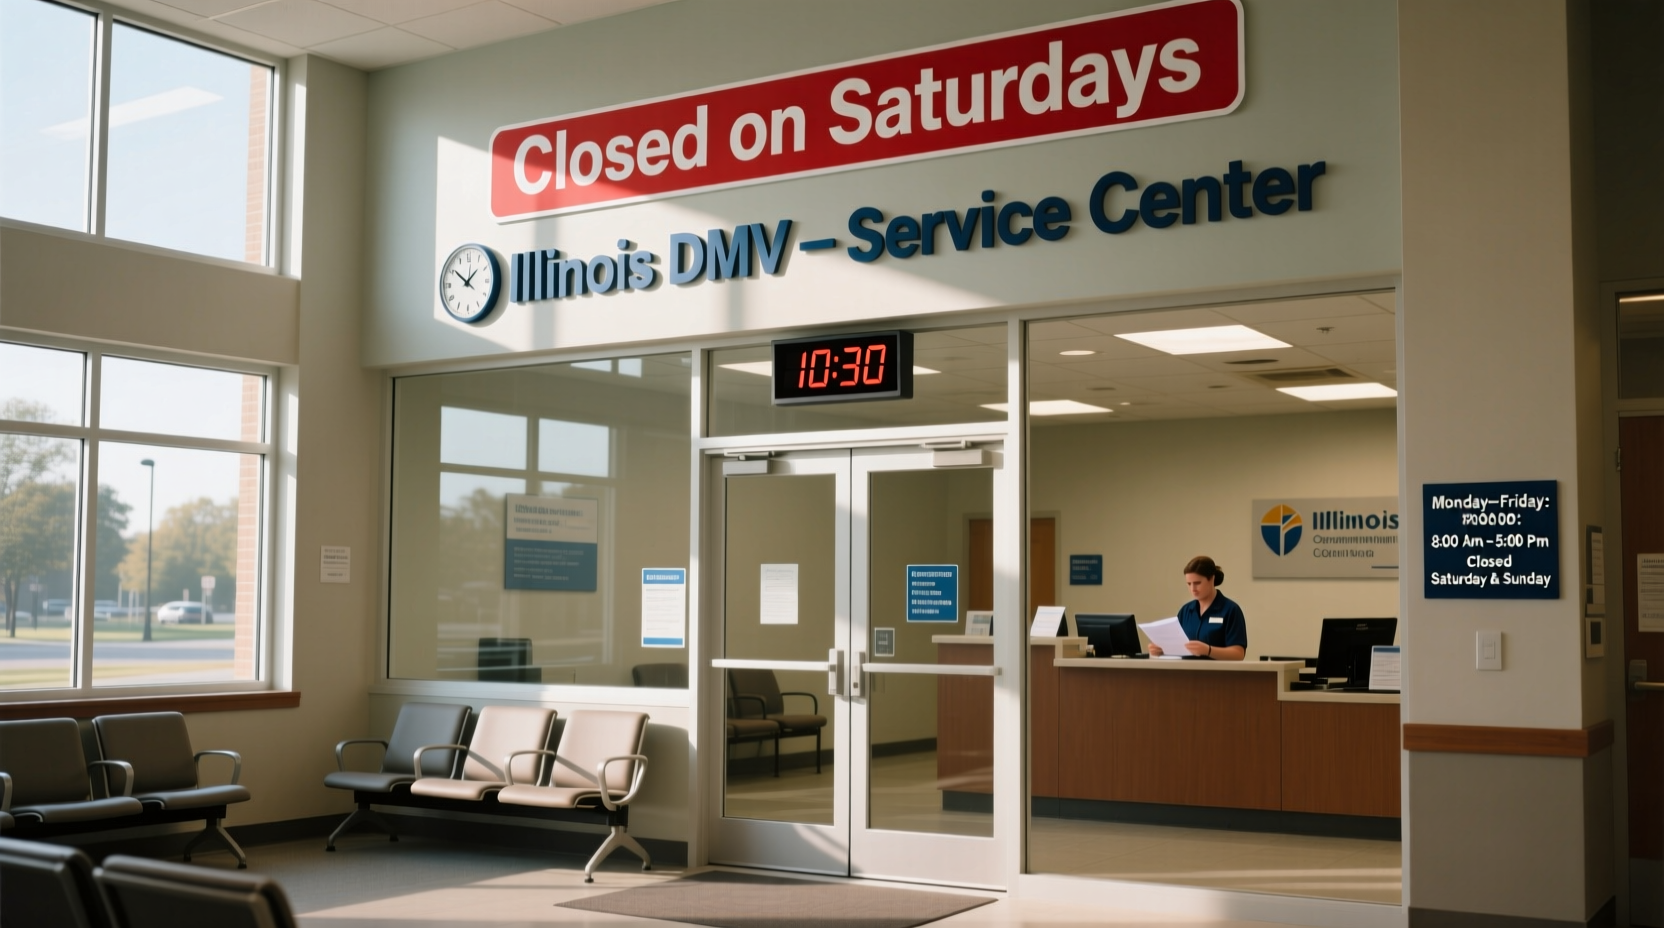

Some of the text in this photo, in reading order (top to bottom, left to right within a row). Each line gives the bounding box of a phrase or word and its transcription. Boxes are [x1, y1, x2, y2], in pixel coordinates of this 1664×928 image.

[513, 37, 1201, 195] Closed on Saturdays
[510, 239, 655, 303] Illinois
[669, 219, 793, 285] DMV
[847, 189, 1072, 263] Service
[1089, 160, 1326, 234] Center
[798, 344, 887, 388] 10:30
[1431, 572, 1551, 588] Saturday & Sunday
[1466, 554, 1512, 568] Closed
